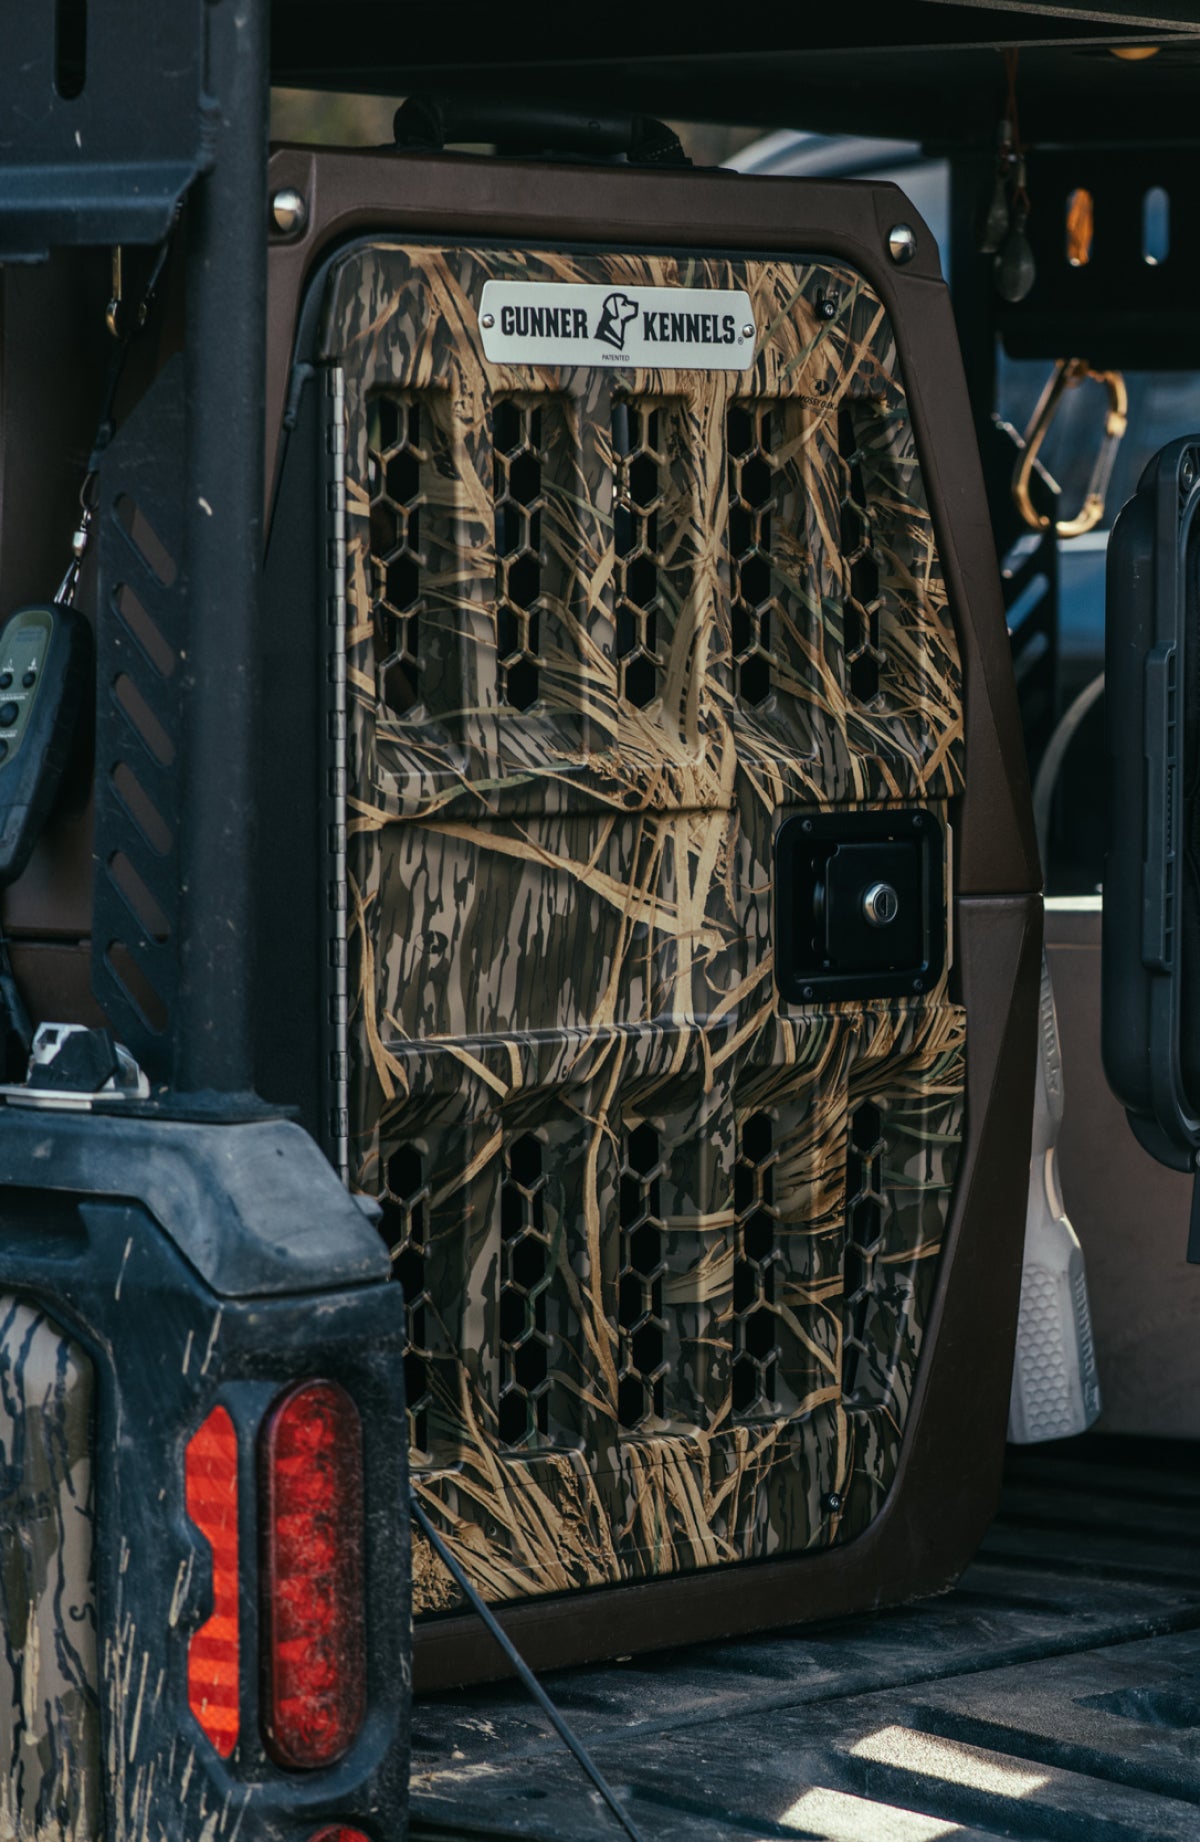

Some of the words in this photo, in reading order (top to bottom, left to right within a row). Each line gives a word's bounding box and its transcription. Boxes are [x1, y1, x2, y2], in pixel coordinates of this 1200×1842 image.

[501, 305, 589, 339] GUNNER
[642, 311, 736, 344] KENNELS
[601, 354, 631, 362] PATENTED
